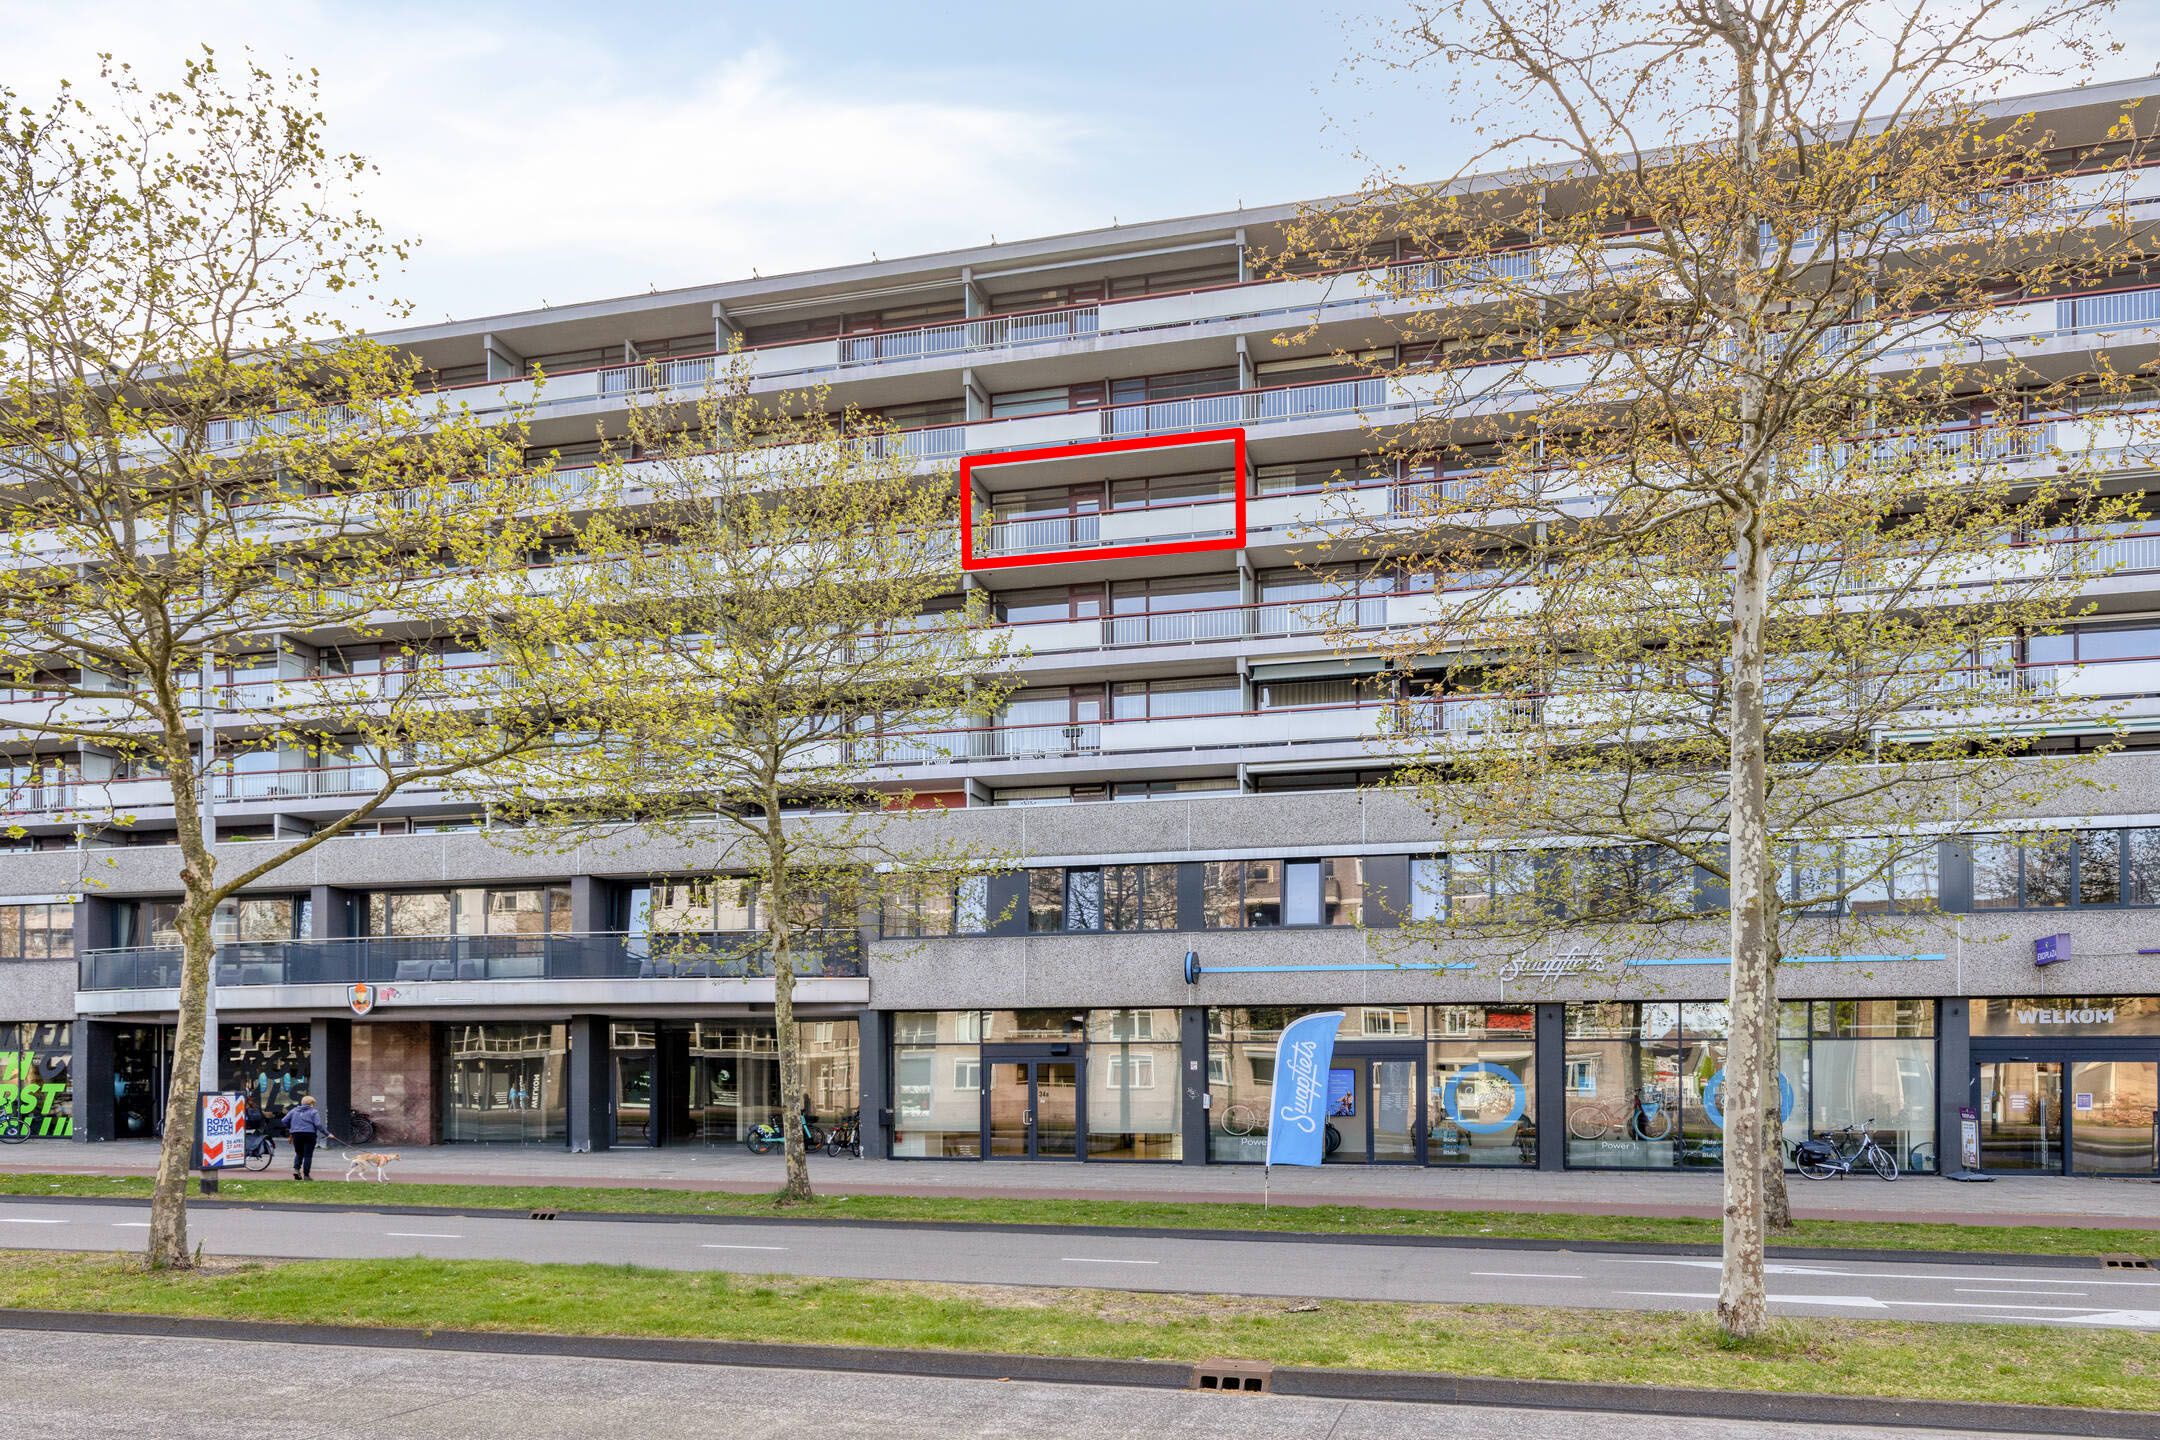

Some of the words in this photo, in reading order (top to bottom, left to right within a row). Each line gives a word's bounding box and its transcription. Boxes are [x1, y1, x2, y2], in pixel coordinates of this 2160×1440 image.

[2017, 1008, 2114, 1024] WELKOM
[1281, 1040, 1322, 1133] Swapfiets
[1241, 1137, 1268, 1146] Powe
[1601, 1142, 1629, 1150] Power
